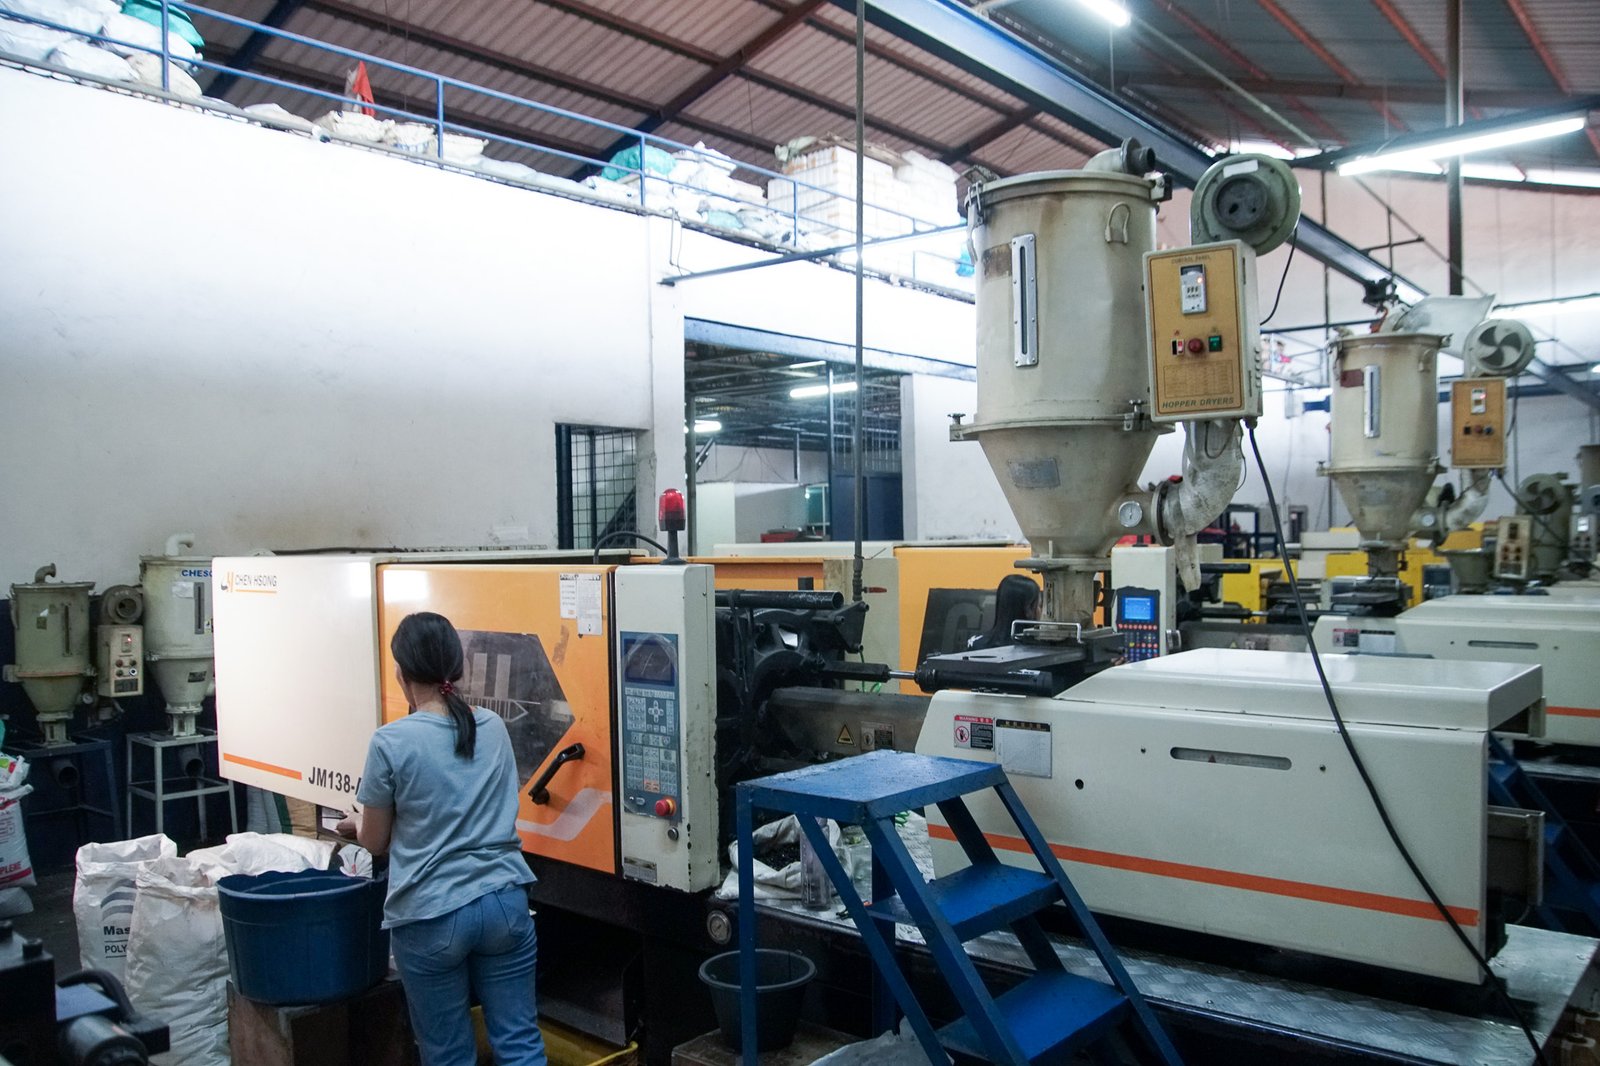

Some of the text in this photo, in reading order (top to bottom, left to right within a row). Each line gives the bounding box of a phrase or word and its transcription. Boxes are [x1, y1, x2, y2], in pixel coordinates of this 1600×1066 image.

[1162, 396, 1234, 408] HOPPER DRYERS
[235, 574, 277, 587] CHEN HSONG
